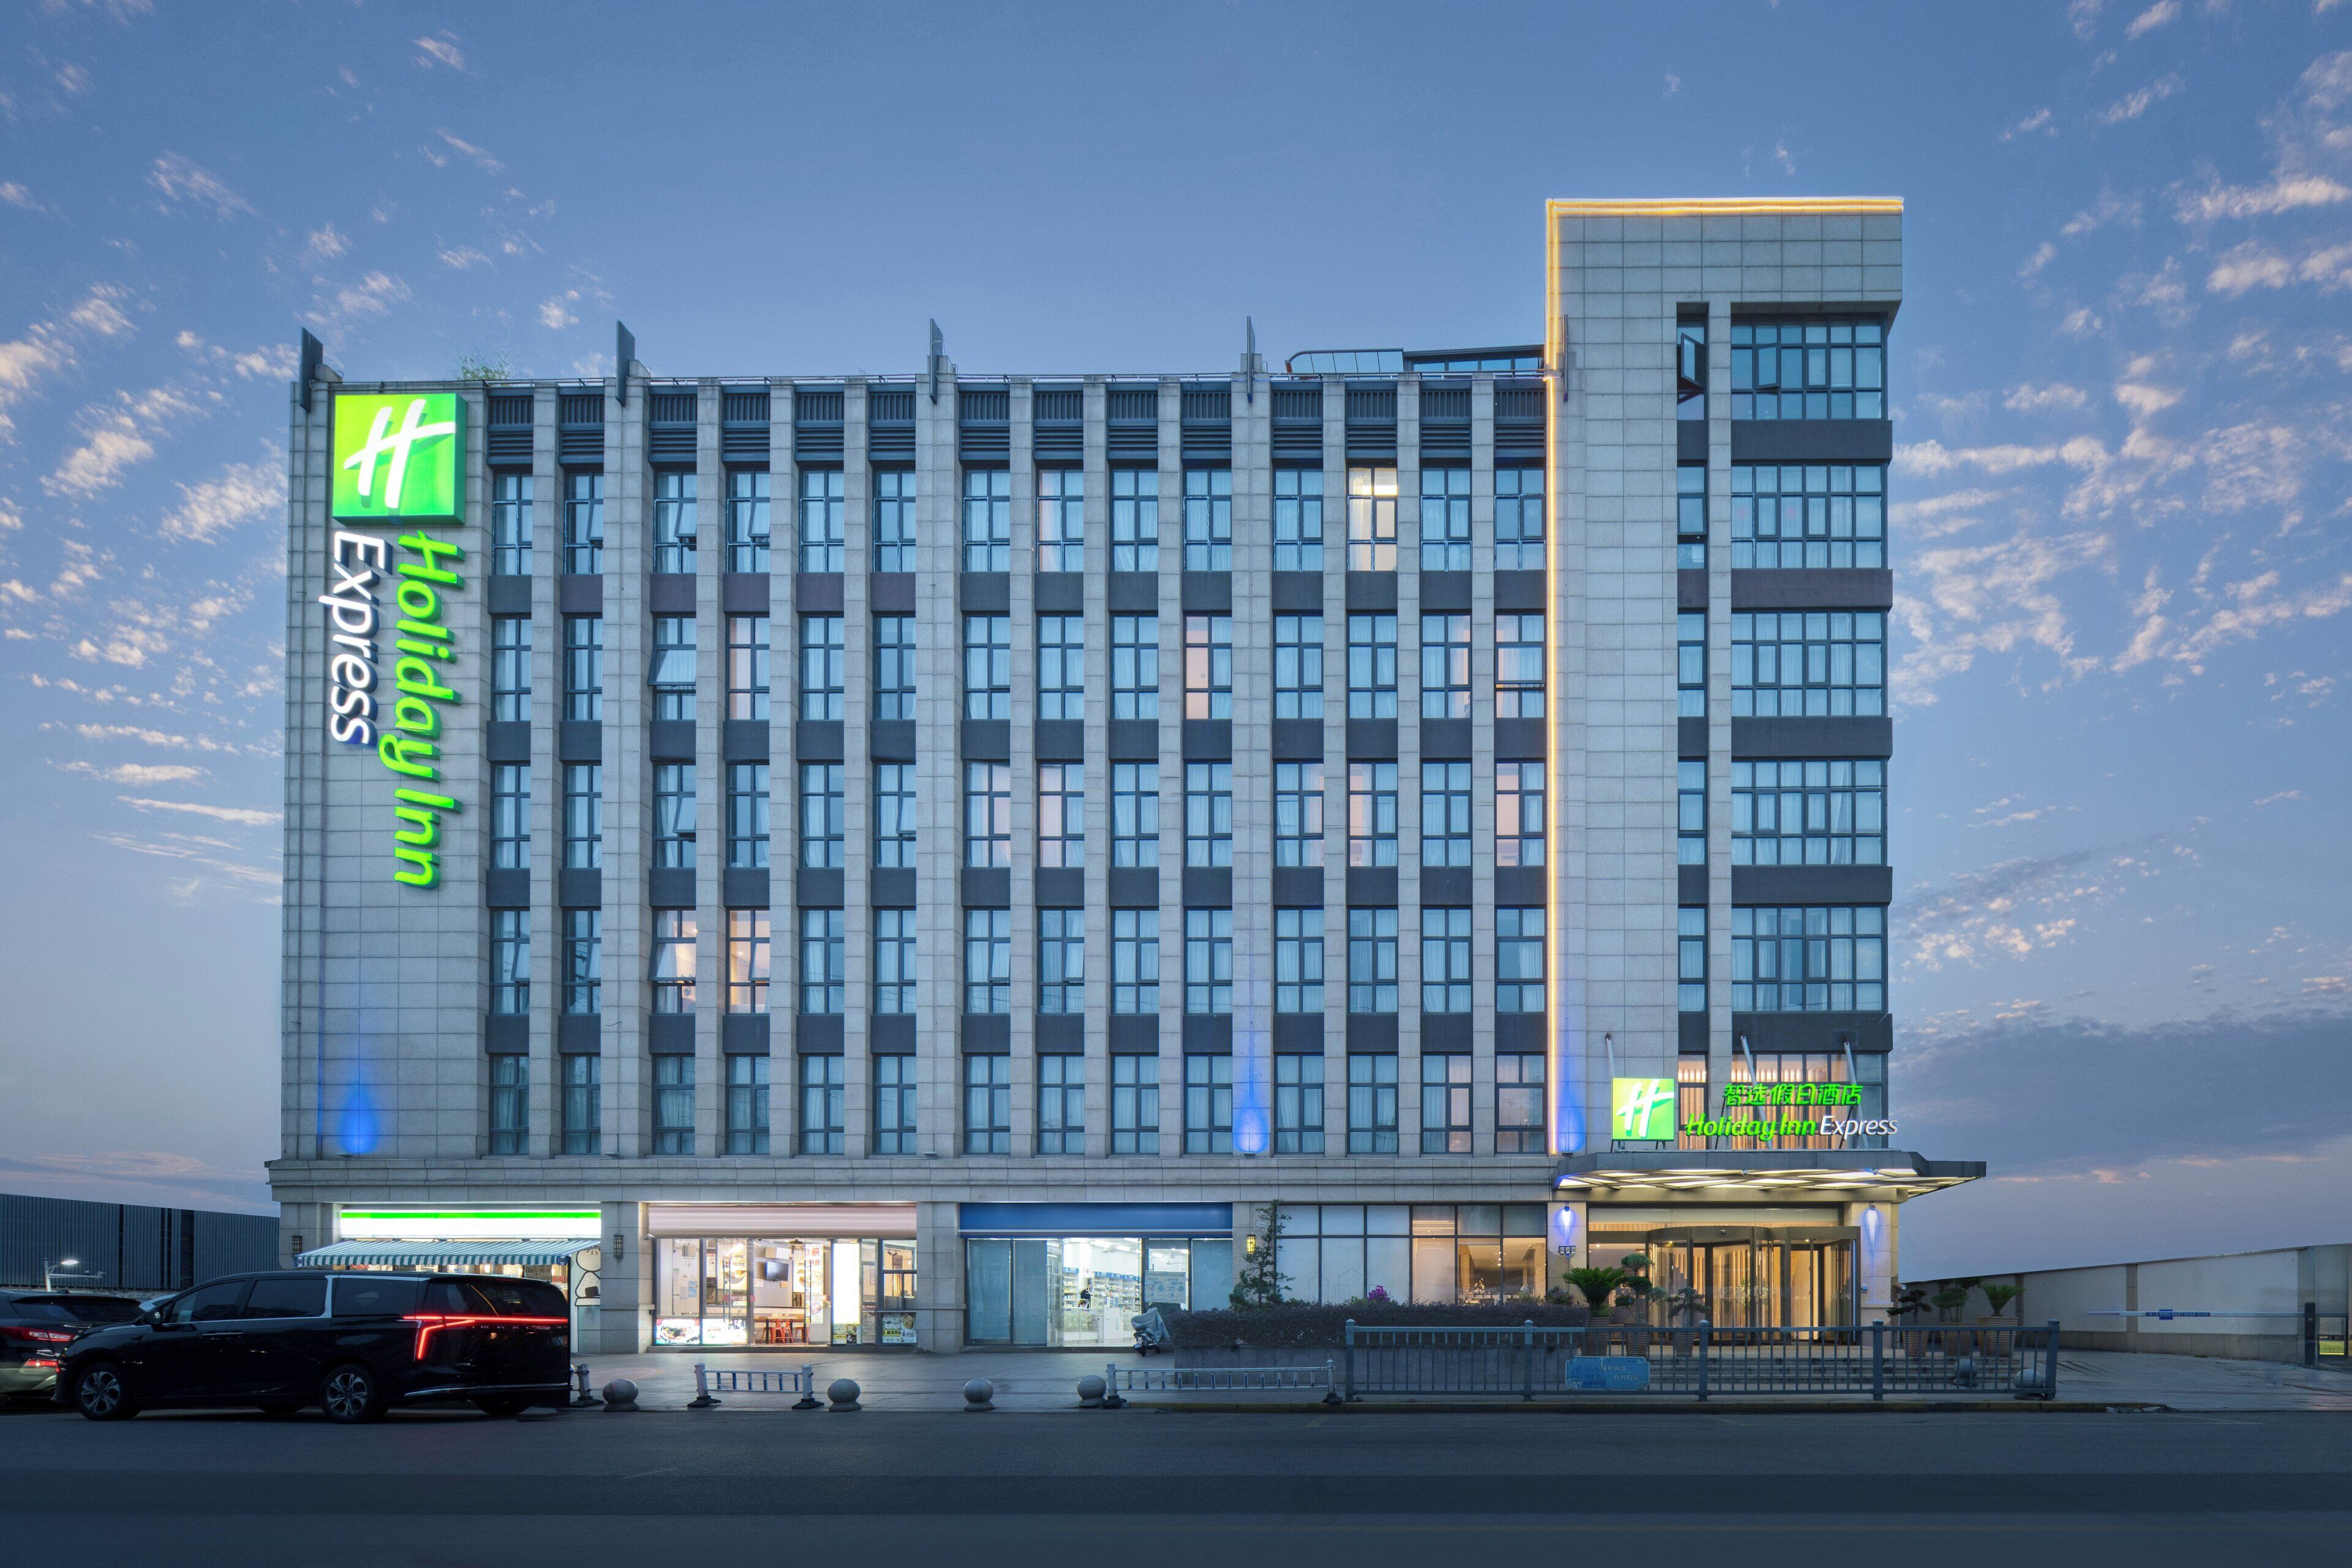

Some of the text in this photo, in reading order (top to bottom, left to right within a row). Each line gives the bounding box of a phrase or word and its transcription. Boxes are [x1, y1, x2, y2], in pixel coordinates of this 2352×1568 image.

[318, 531, 385, 745] Express
[379, 530, 458, 886] Holiday Inn
[1685, 1114, 1899, 1141] Holiday Inn Express
[1723, 1084, 1863, 1106] 智选假日酒店
